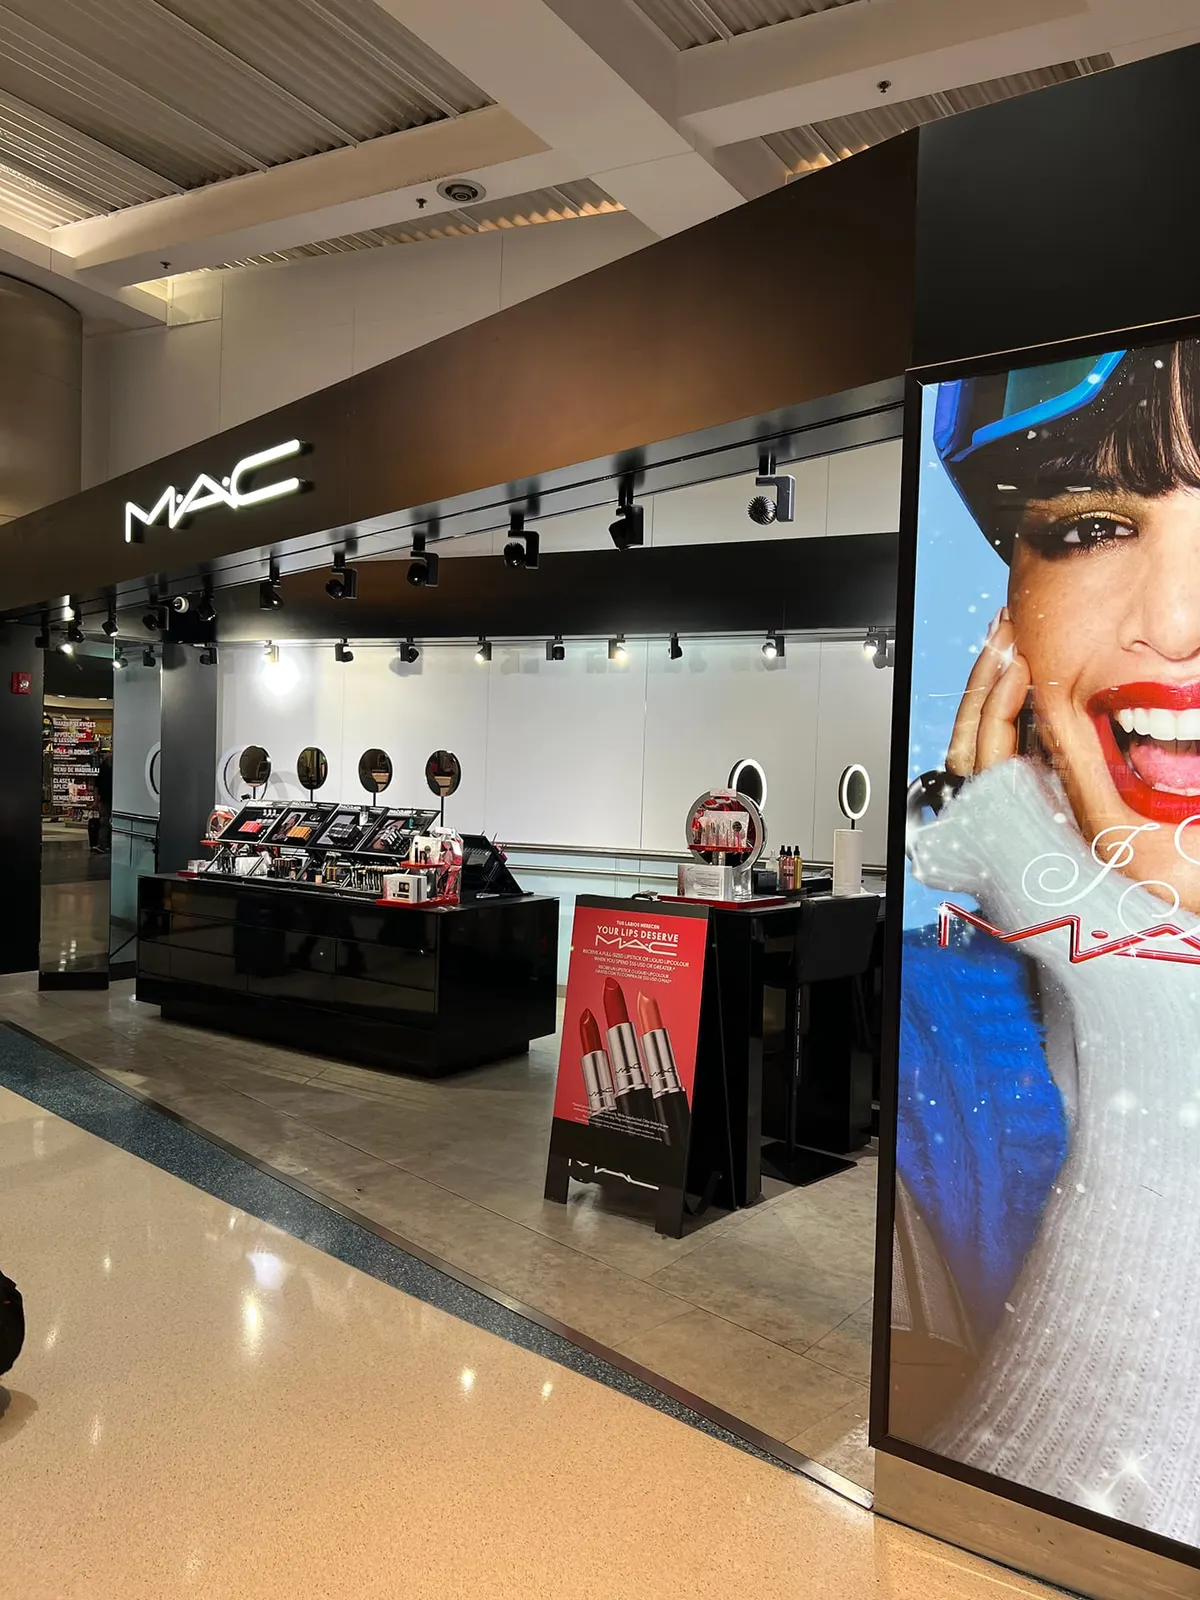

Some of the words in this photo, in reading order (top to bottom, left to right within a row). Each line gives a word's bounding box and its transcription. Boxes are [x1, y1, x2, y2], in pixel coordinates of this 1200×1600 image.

[597, 925, 619, 935] YOUR
[621, 928, 639, 938] LIPS
[641, 930, 679, 942] DESERVE
[664, 959, 690, 967] LIPCOLOUR
